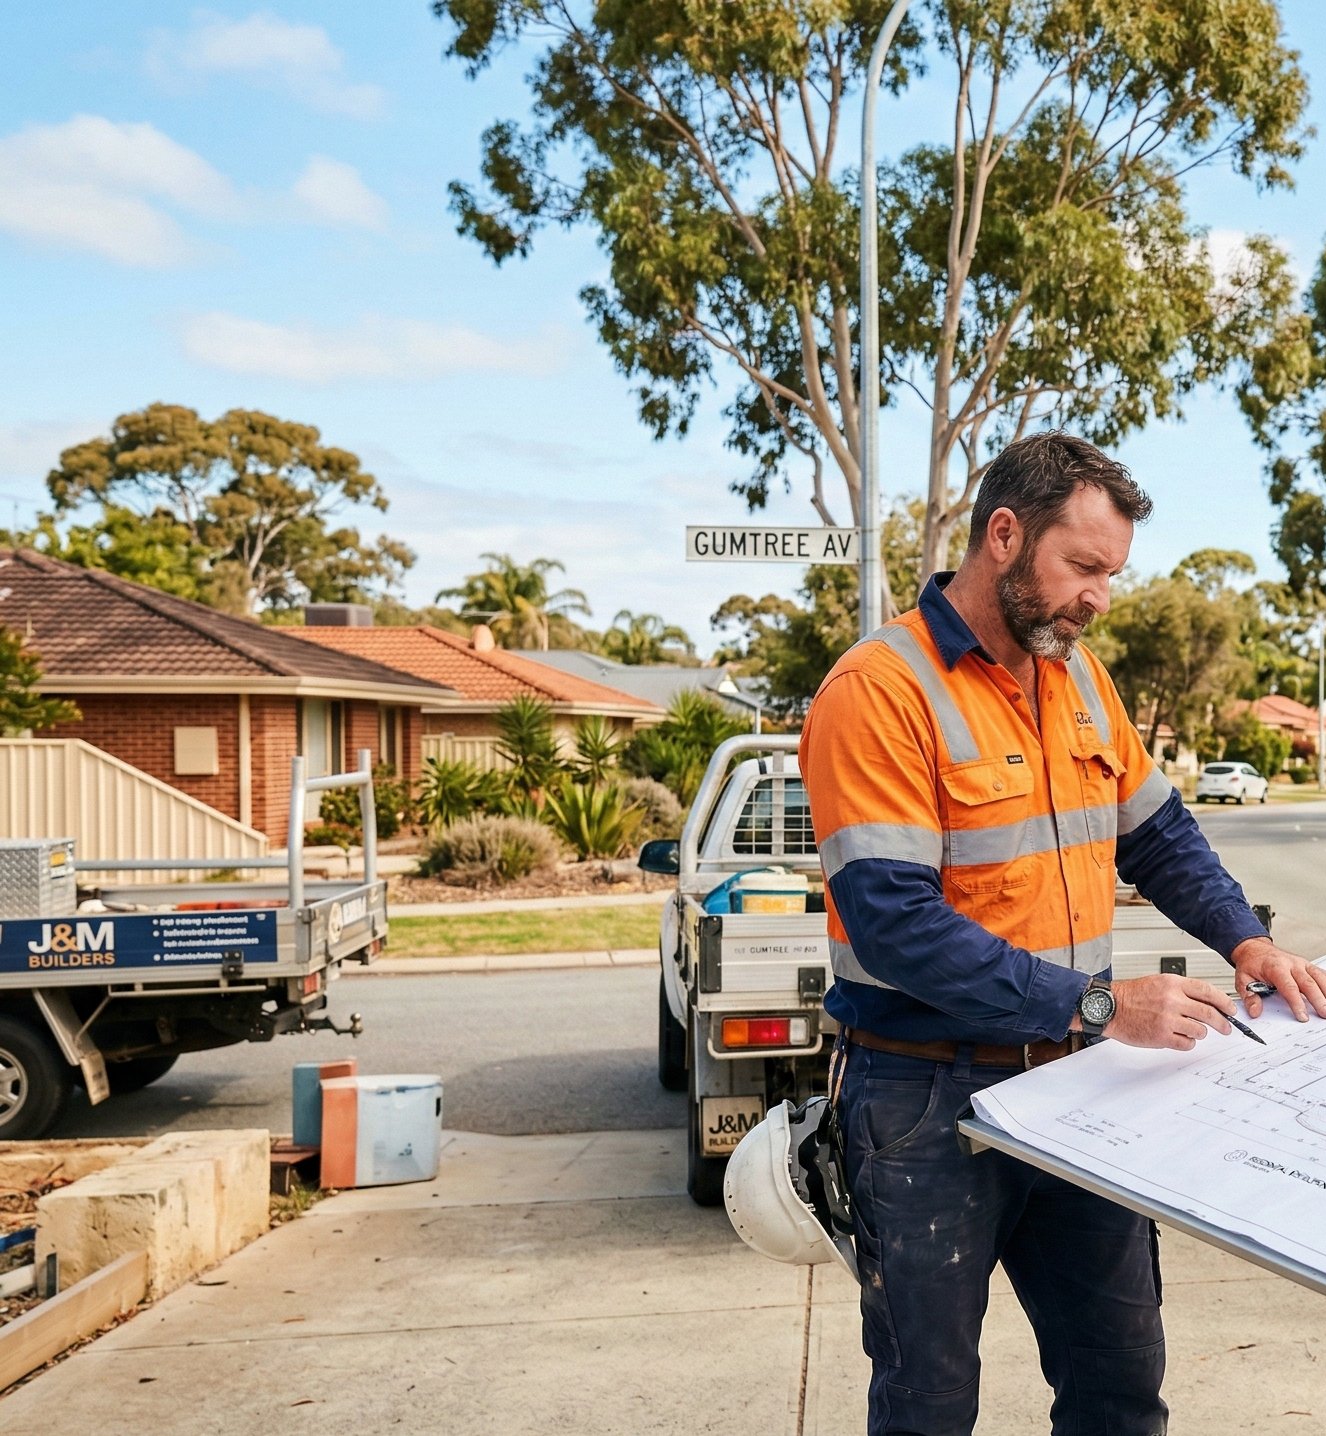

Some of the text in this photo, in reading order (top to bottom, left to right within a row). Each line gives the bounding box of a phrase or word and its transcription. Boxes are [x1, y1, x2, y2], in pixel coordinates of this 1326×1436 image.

[694, 531, 852, 558] GUMTREE AV
[28, 921, 115, 954] J&M
[28, 952, 115, 969] BUILDERS
[708, 1112, 759, 1135] J&M
